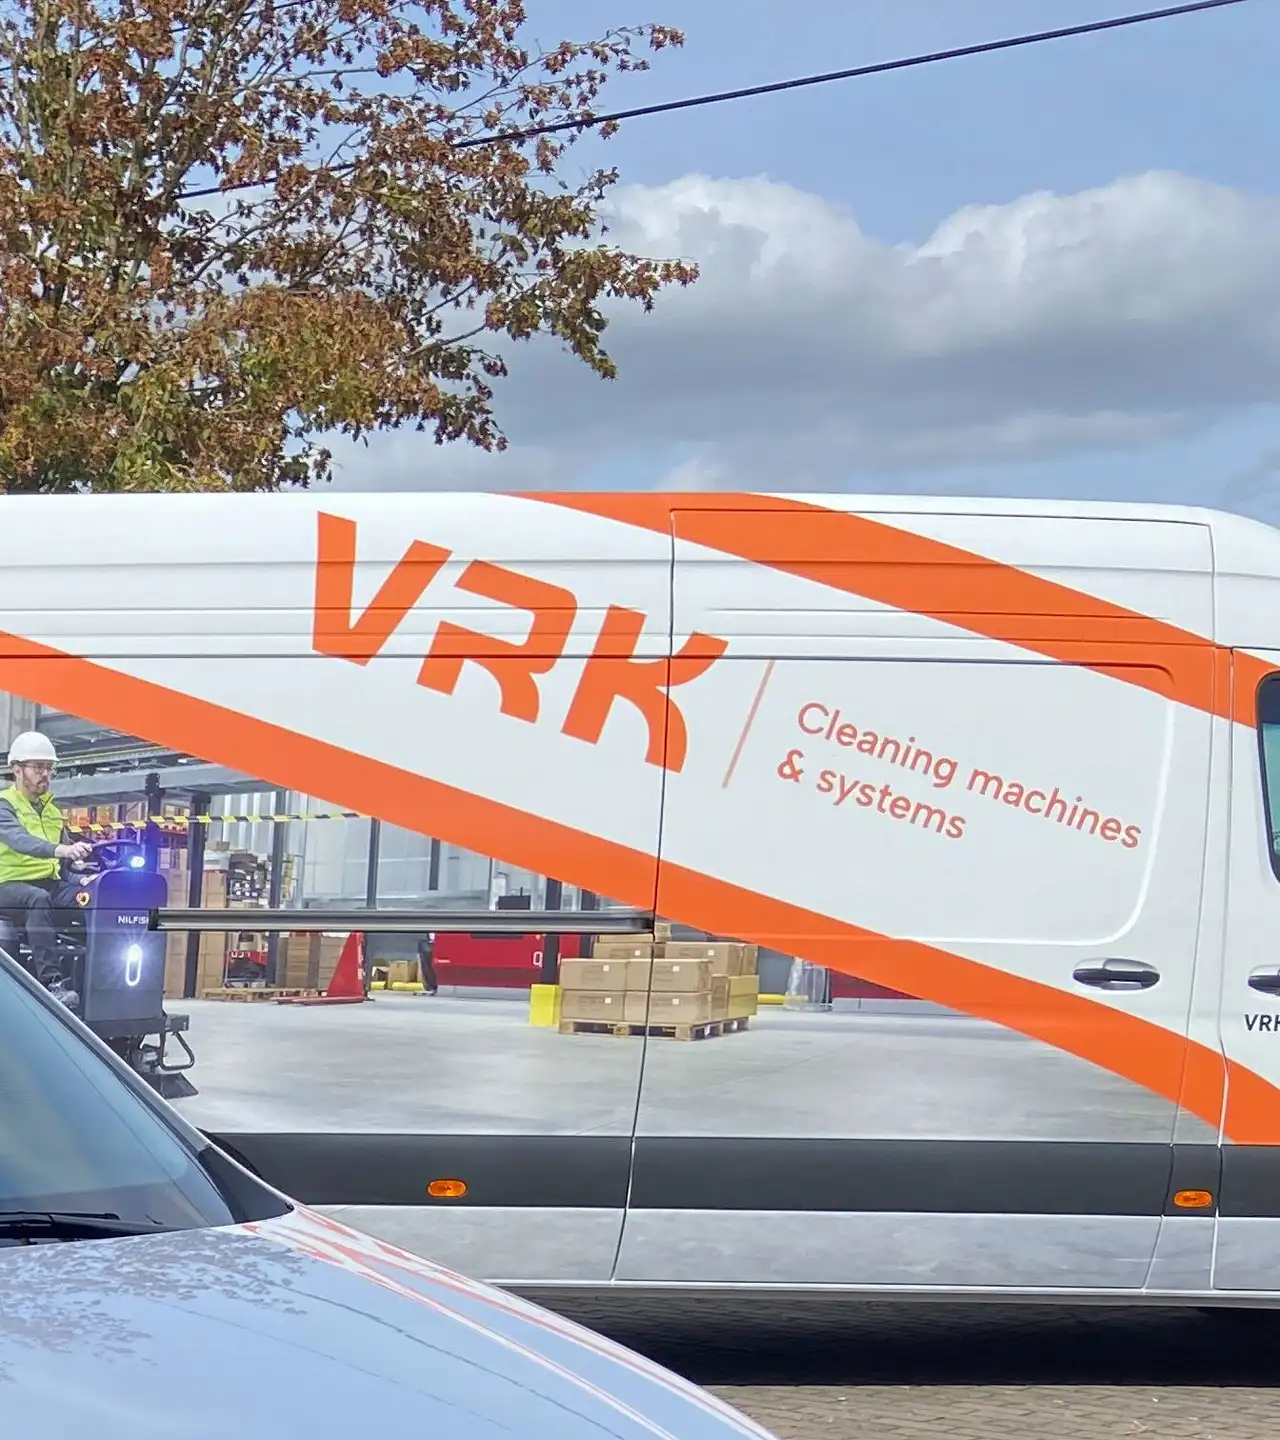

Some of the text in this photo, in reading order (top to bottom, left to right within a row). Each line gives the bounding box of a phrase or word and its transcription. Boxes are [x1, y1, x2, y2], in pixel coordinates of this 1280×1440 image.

[312, 512, 728, 773] VRK
[776, 748, 967, 839] & systems
[797, 701, 1142, 849] Cleaning machines
